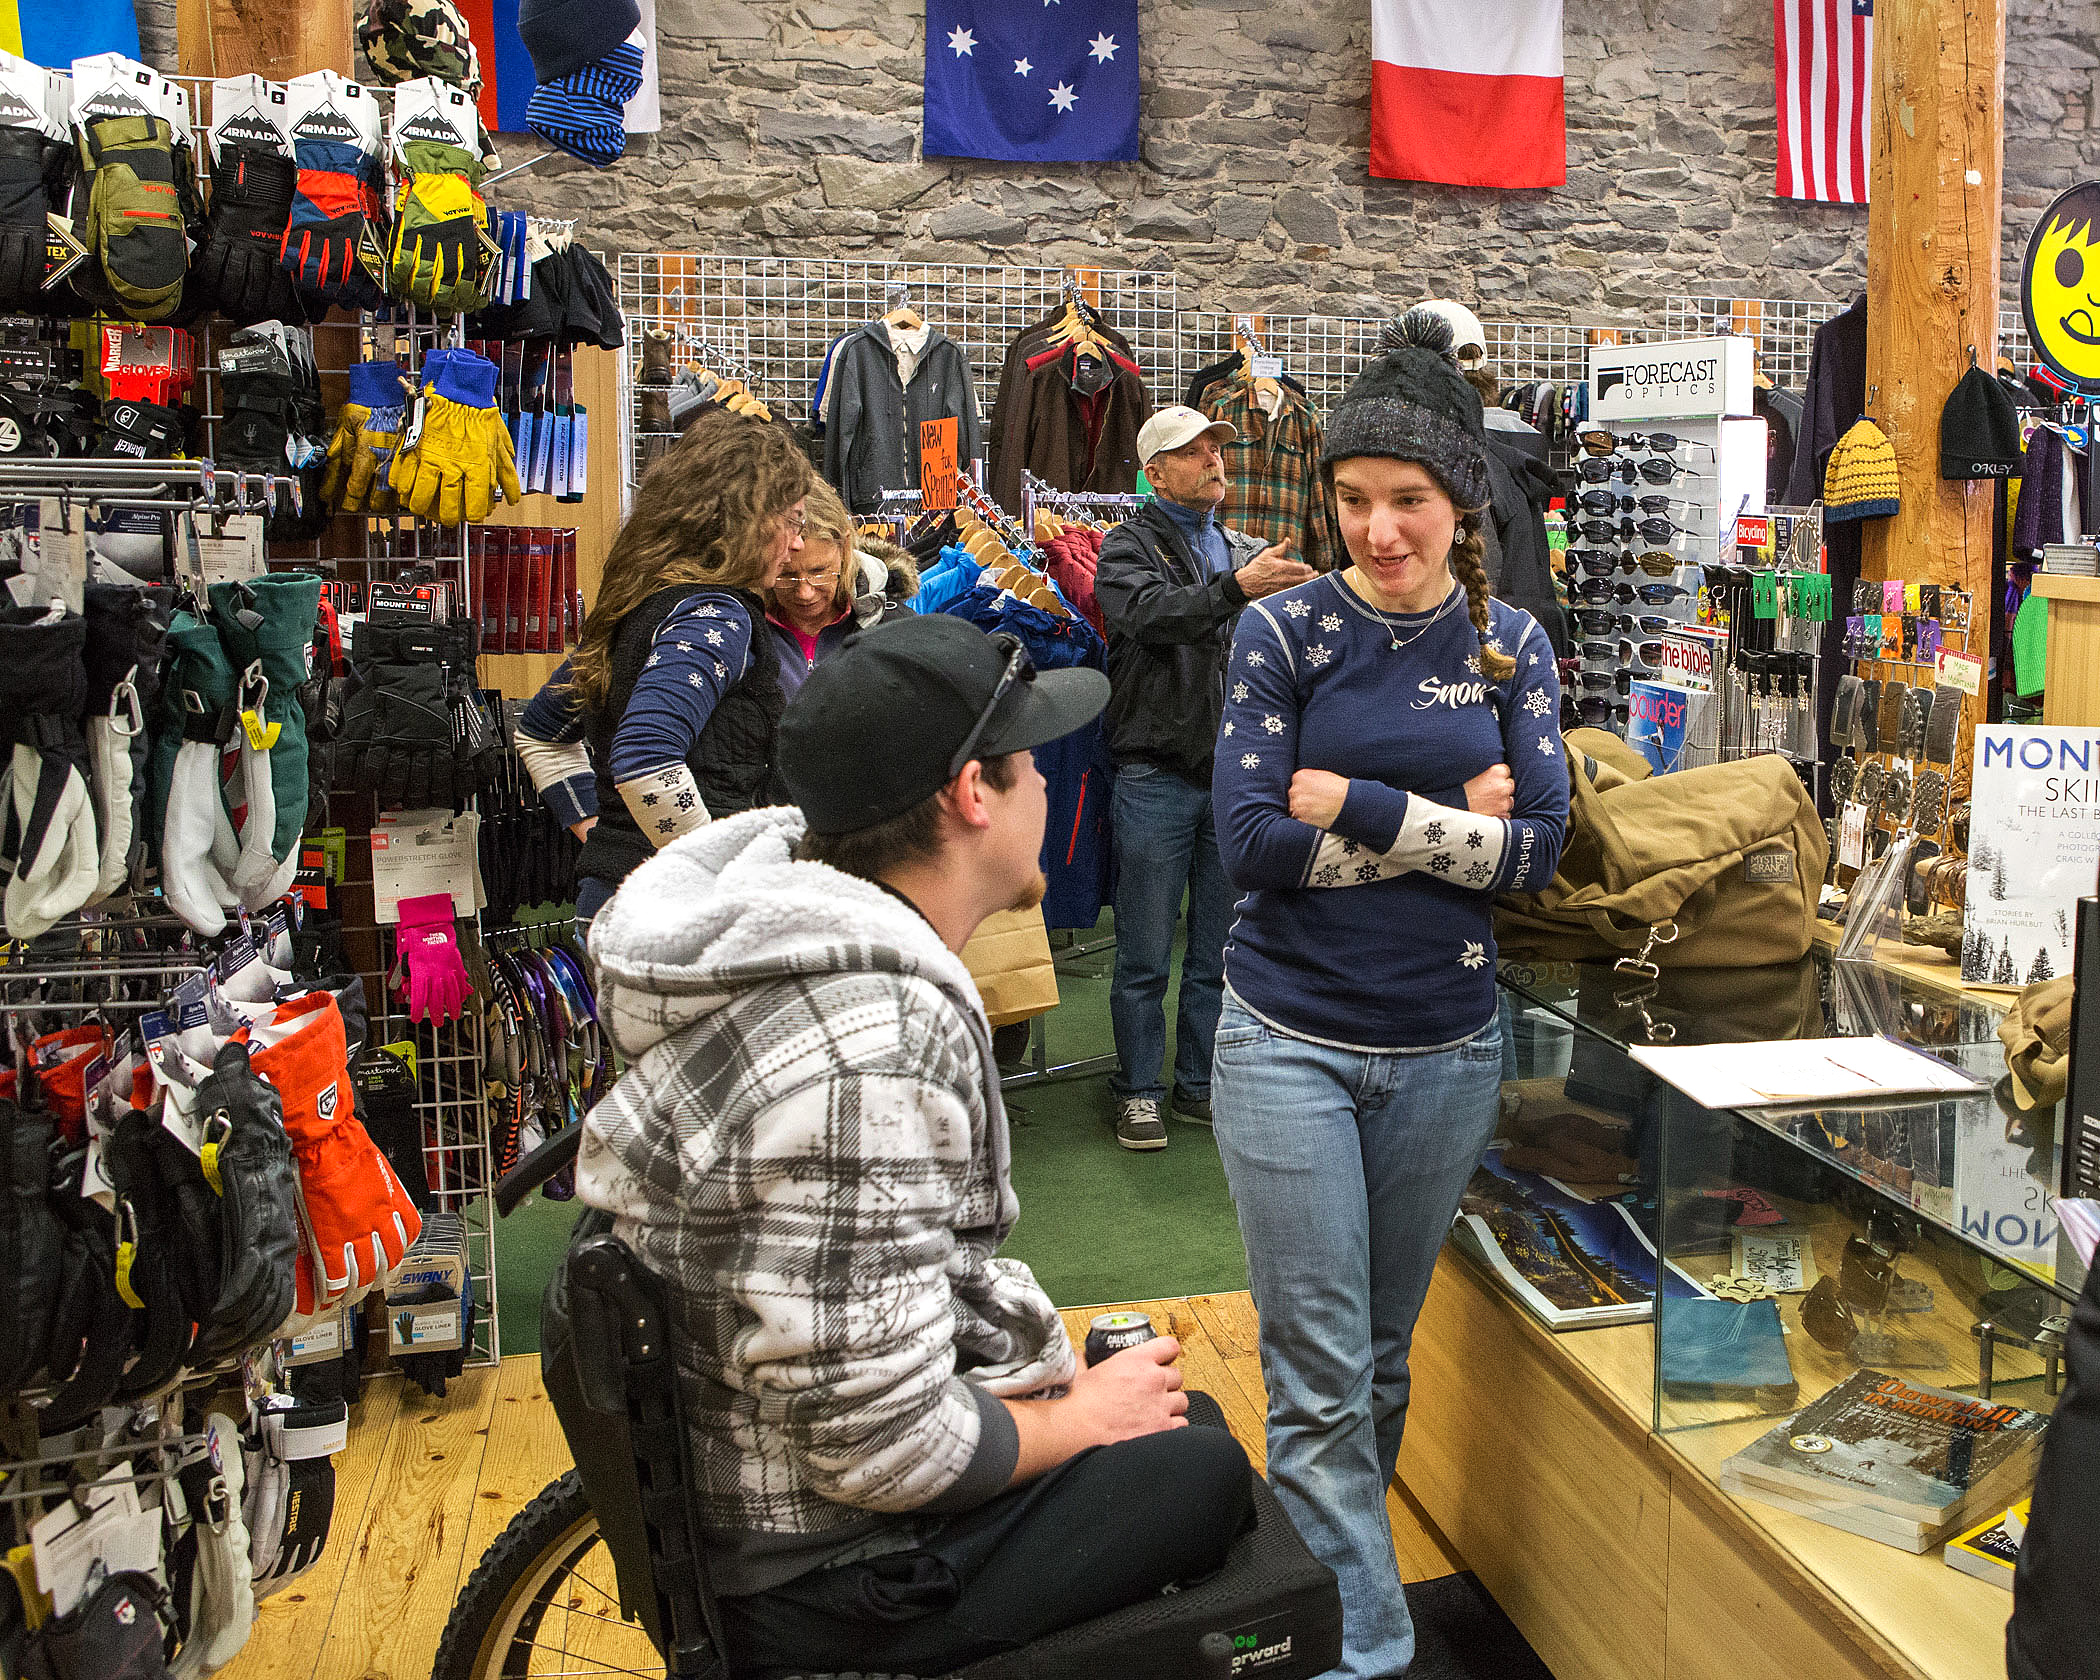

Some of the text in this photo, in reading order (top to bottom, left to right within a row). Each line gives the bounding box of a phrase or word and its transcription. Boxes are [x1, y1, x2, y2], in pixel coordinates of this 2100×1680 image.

[224, 127, 282, 143] ARMADA
[297, 124, 352, 138] ARMADA
[402, 126, 458, 142] ARMADA
[104, 328, 123, 373] MARKER
[119, 363, 170, 378] GLOVES
[1625, 359, 1718, 387] FORECAST
[1625, 382, 1715, 400] OPTICS
[1971, 463, 2014, 475] OAKLEY
[1738, 524, 1766, 543] Bicycling
[375, 600, 427, 611] MOUNT TEC
[1409, 676, 1500, 710] Snow
[2018, 805, 2047, 818] THE
[2052, 807, 2088, 819] LAST
[1751, 854, 1789, 865] MYSTERY
[1759, 863, 1789, 873] RANCH
[401, 1269, 454, 1285] SWANY
[1877, 1379, 2020, 1423] Downhill
[1892, 1399, 2000, 1433] MONTANA
[288, 1490, 303, 1536] HESTRA
[1231, 1635, 1292, 1668] orward
